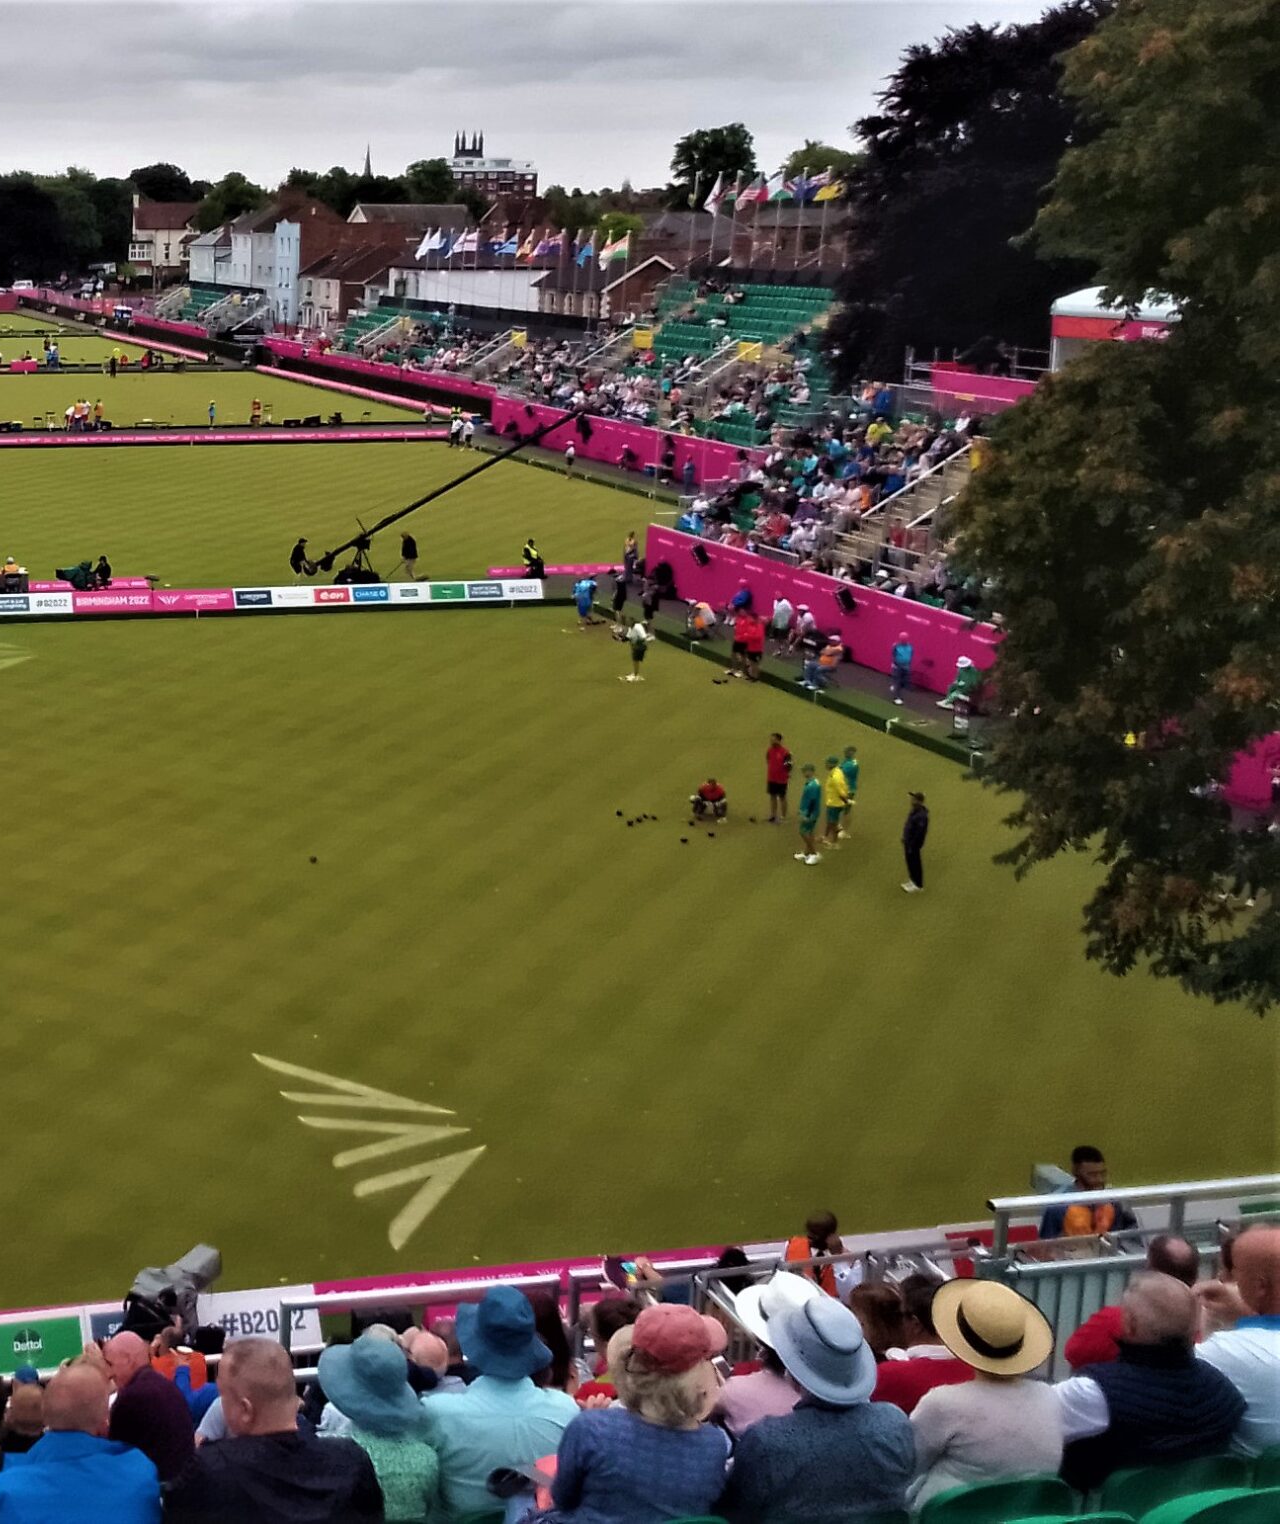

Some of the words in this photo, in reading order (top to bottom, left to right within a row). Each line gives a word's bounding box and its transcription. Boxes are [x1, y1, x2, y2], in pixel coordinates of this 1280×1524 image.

[75, 596, 128, 606] BIRMINGHAM
[130, 595, 150, 605] 2022
[221, 1308, 308, 1337] #B202
[13, 1338, 43, 1351] Dettol
